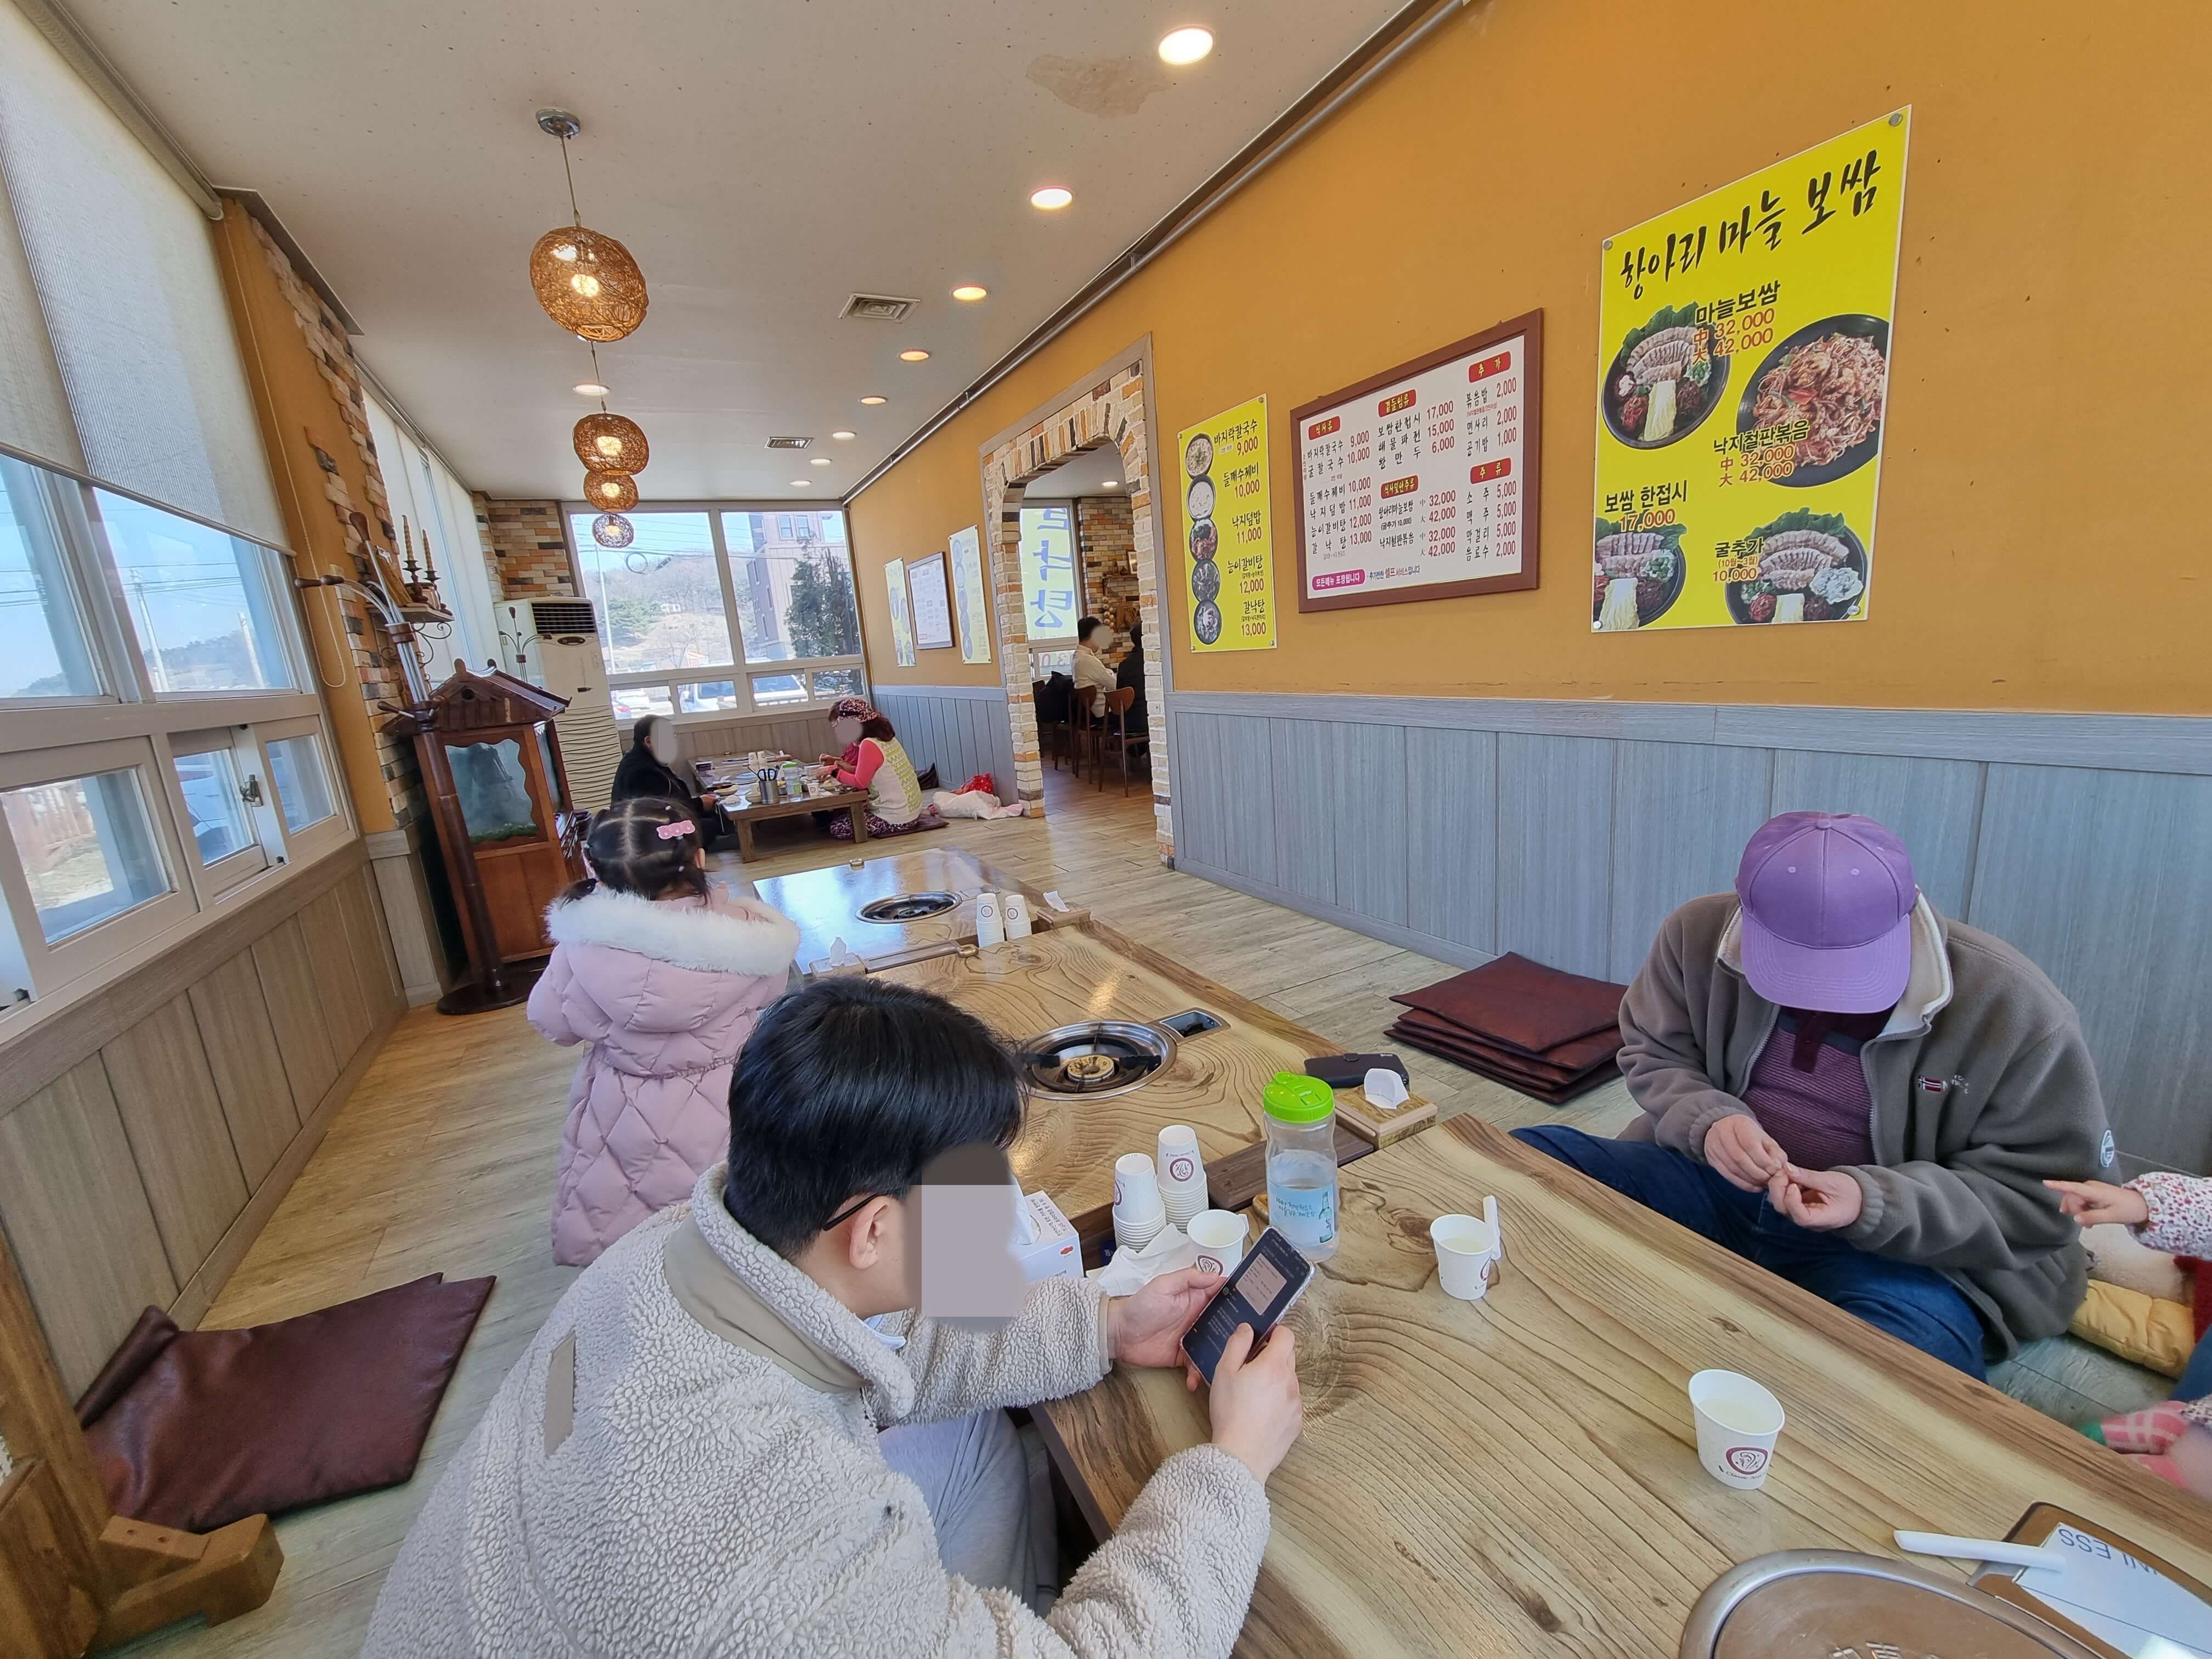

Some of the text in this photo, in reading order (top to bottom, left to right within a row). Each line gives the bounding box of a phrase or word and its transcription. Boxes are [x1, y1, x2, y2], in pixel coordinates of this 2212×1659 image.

[1621, 149, 1881, 300] 항아리 마늘 보쌈
[1695, 280, 1781, 326] 마늘보쌈
[1694, 308, 1775, 346] 中 32,000
[1692, 328, 1774, 365] 大 42,000
[1466, 386, 1488, 409] 볶음밥
[1497, 377, 1516, 399] 2,000
[1426, 400, 1454, 420] 17,000
[1467, 416, 1488, 435] 면사리
[1497, 405, 1517, 426] 2,000
[1214, 418, 1258, 445] 바지락칼국수
[1316, 420, 1333, 436] 식사류
[1427, 419, 1454, 437] 15,000
[1713, 419, 1810, 455] 낙지철판볶음
[1237, 436, 1259, 457] 9,000
[1307, 430, 1369, 461] 바지락칼국수 9,000
[1432, 436, 1454, 454] 6,000
[1466, 427, 1516, 456] 공기밥 1,000
[1347, 447, 1370, 464] 10,000
[1720, 445, 1795, 473] 中 32,000
[1223, 462, 1259, 488] 들깨수제비
[1719, 462, 1794, 488] 大 42,000
[1235, 479, 1260, 499] 10,000
[1310, 476, 1371, 505] 들깨수제비 10,000
[1429, 490, 1456, 506] 32,000
[1497, 481, 1516, 500] 5,000
[1604, 480, 1688, 513] 보쌈 한접시
[1349, 494, 1372, 510] 11,000
[1497, 501, 1516, 520] 5,000
[1232, 509, 1261, 529] 낙지덮밥
[1429, 506, 1456, 523] 42,000
[1620, 508, 1676, 532] 17,000
[1237, 526, 1262, 544] 11,000
[1311, 513, 1372, 538] 능이갈비탕 12,000
[1429, 526, 1455, 542] 32,000
[1466, 521, 1516, 544] 막걸리 5,000
[1350, 531, 1372, 545] 13,000
[1714, 538, 1764, 557] 굴추가
[1429, 541, 1455, 557] 42,000
[1466, 540, 1516, 562] 음료수 2,000
[1227, 555, 1263, 574] 능이갈비탕
[1712, 568, 1757, 582] 10,000
[1239, 578, 1264, 595] 12,000
[1243, 599, 1265, 614] 갈낙탕
[1241, 622, 1266, 637] 13,000
